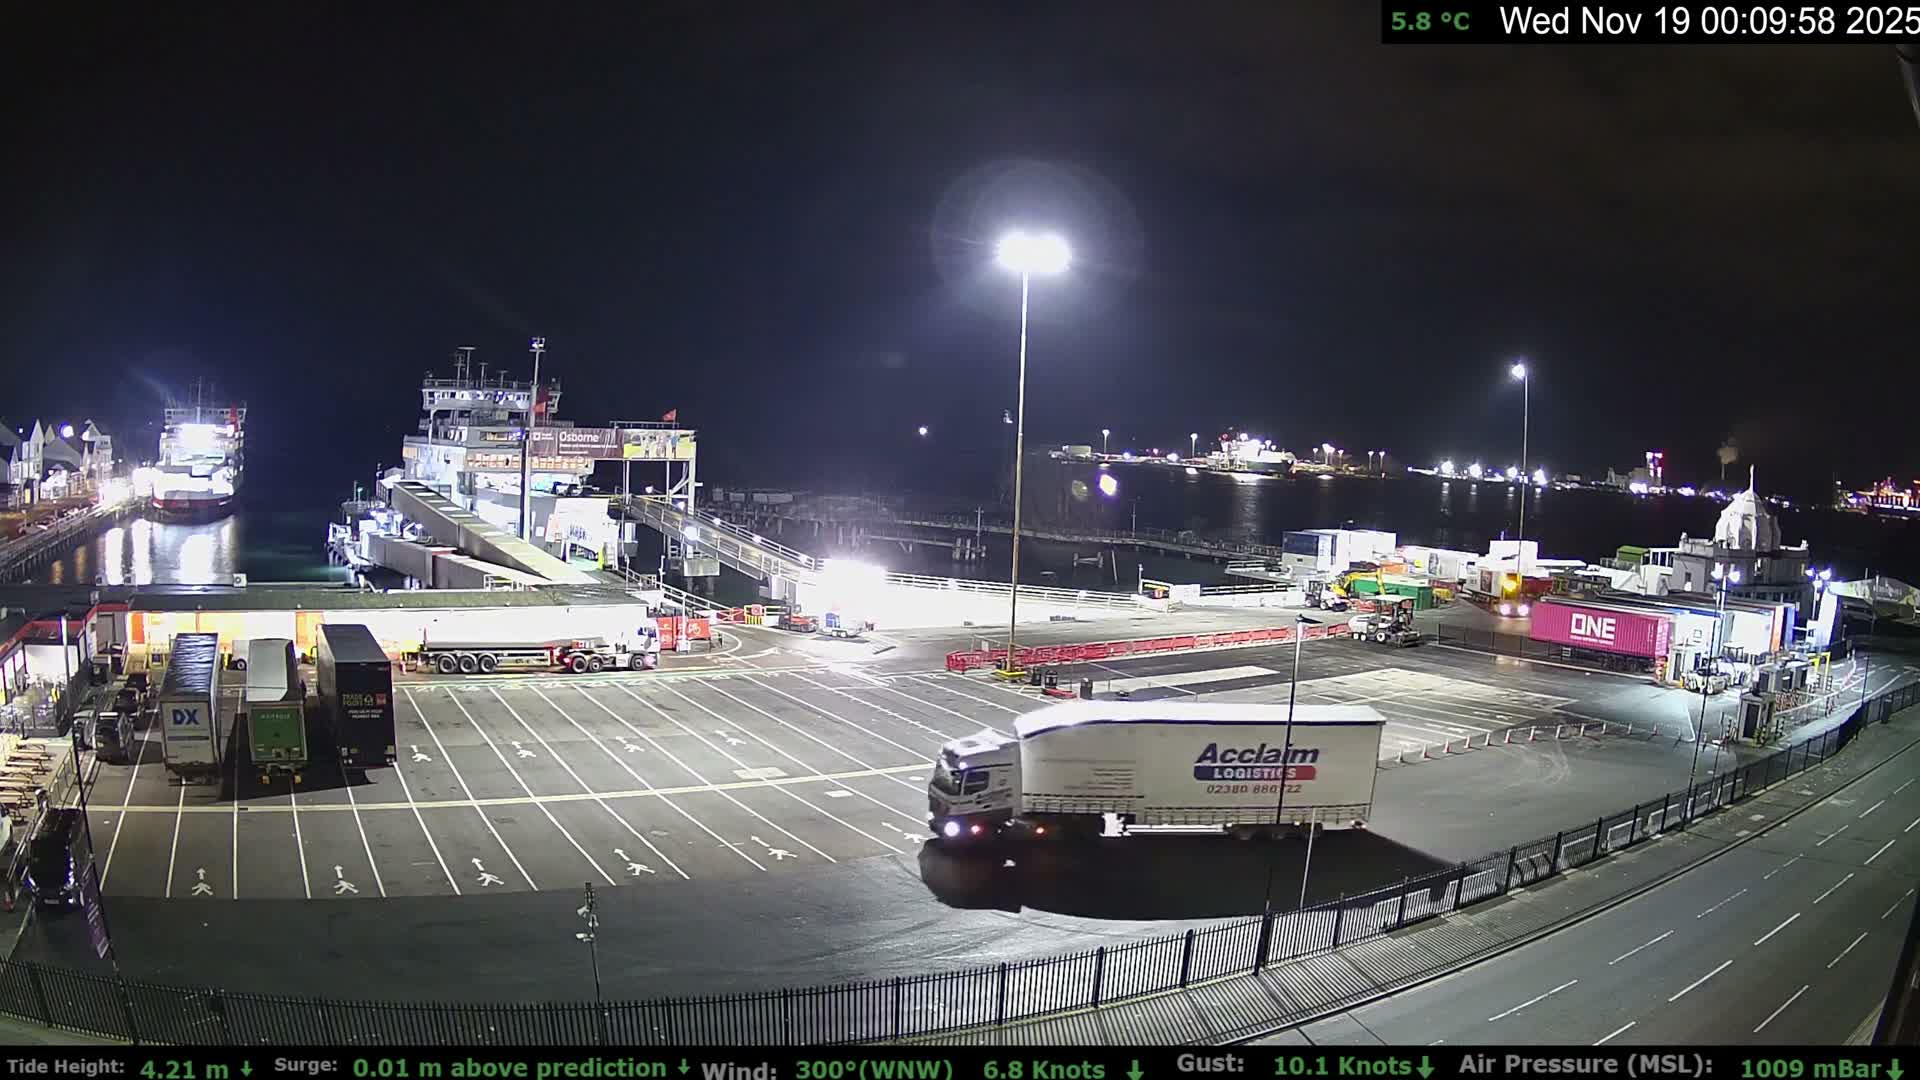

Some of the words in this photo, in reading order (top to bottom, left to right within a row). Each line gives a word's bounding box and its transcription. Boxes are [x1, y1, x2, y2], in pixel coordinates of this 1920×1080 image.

[560, 431, 599, 442] Osborne
[1570, 613, 1616, 639] ONE
[172, 709, 200, 725] DX
[1195, 742, 1319, 764] Acclaim
[1206, 784, 1248, 794] 02380
[1253, 784, 1302, 793] 88022
